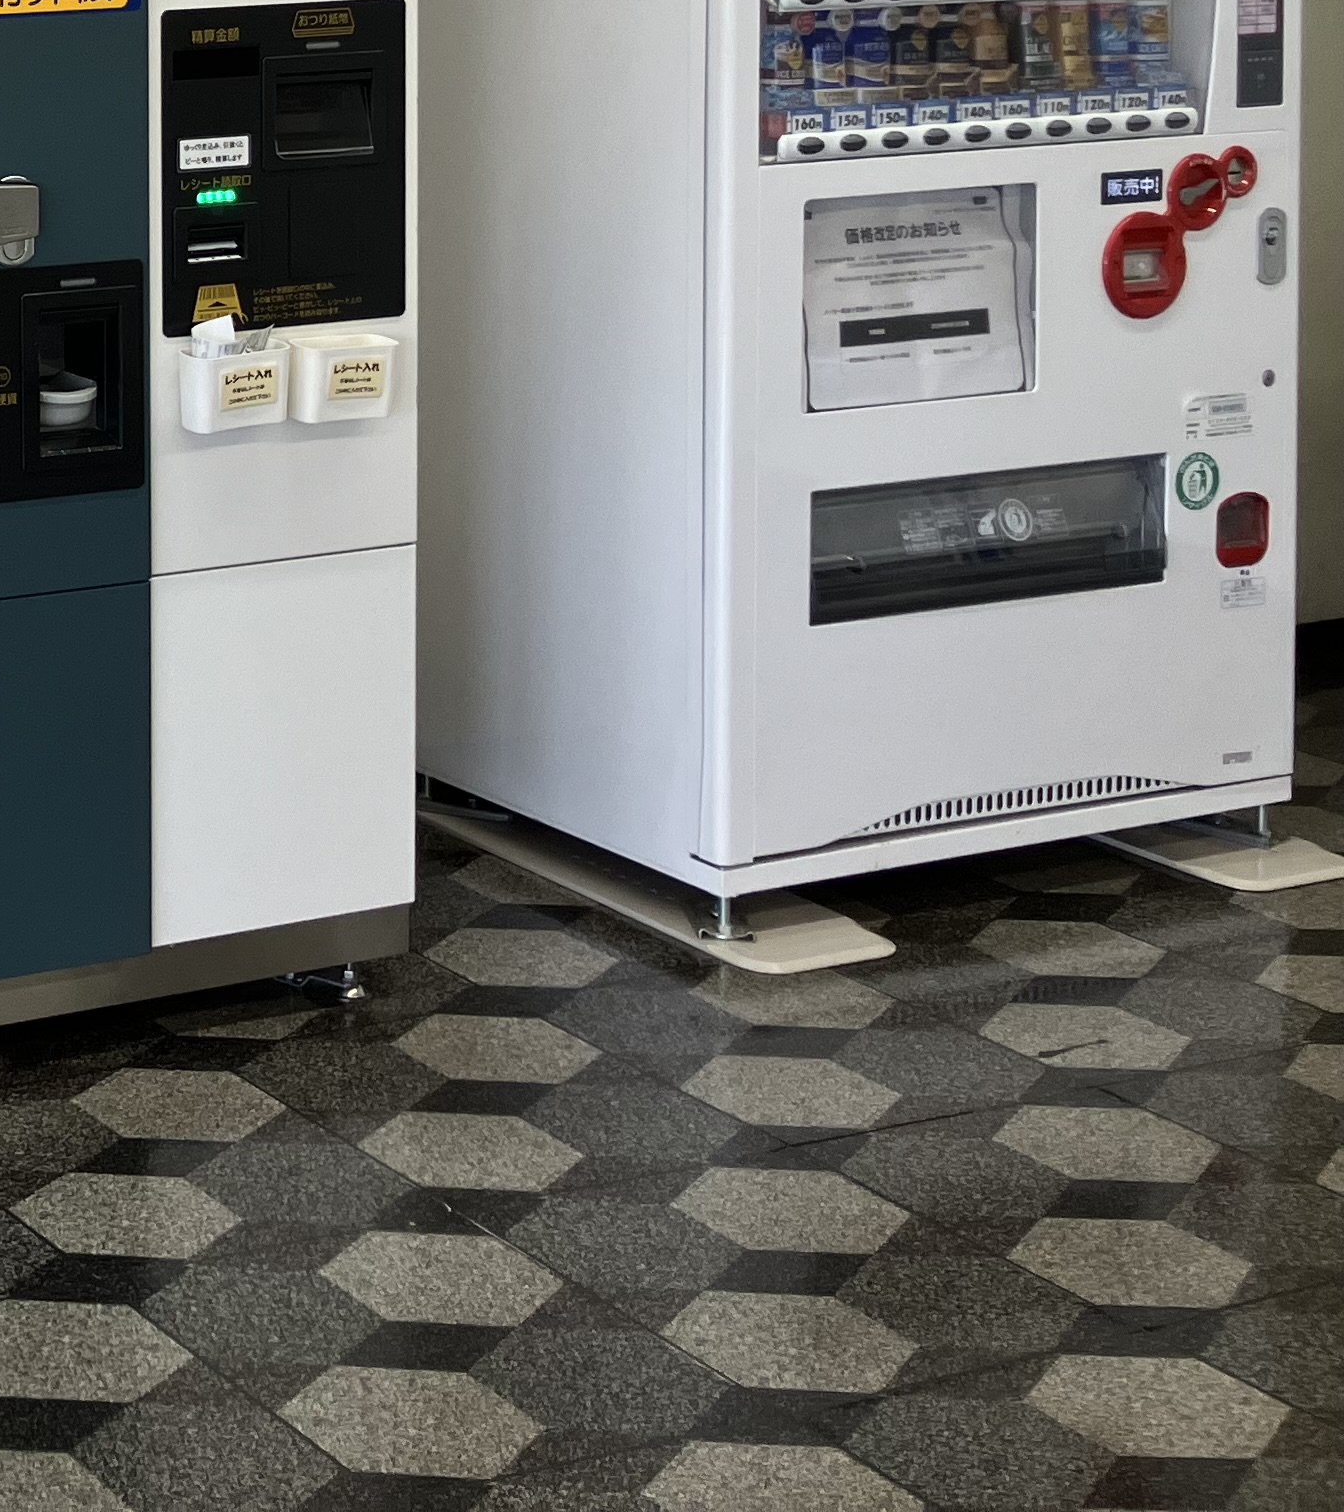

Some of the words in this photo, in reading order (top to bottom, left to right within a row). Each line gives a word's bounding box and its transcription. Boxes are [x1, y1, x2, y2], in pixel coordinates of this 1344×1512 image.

[1107, 176, 1159, 197] 販売中!
[844, 220, 962, 245] 価格改定のお知らせ
[225, 369, 273, 385] レシート入れ
[333, 362, 380, 374] レシート入れ
